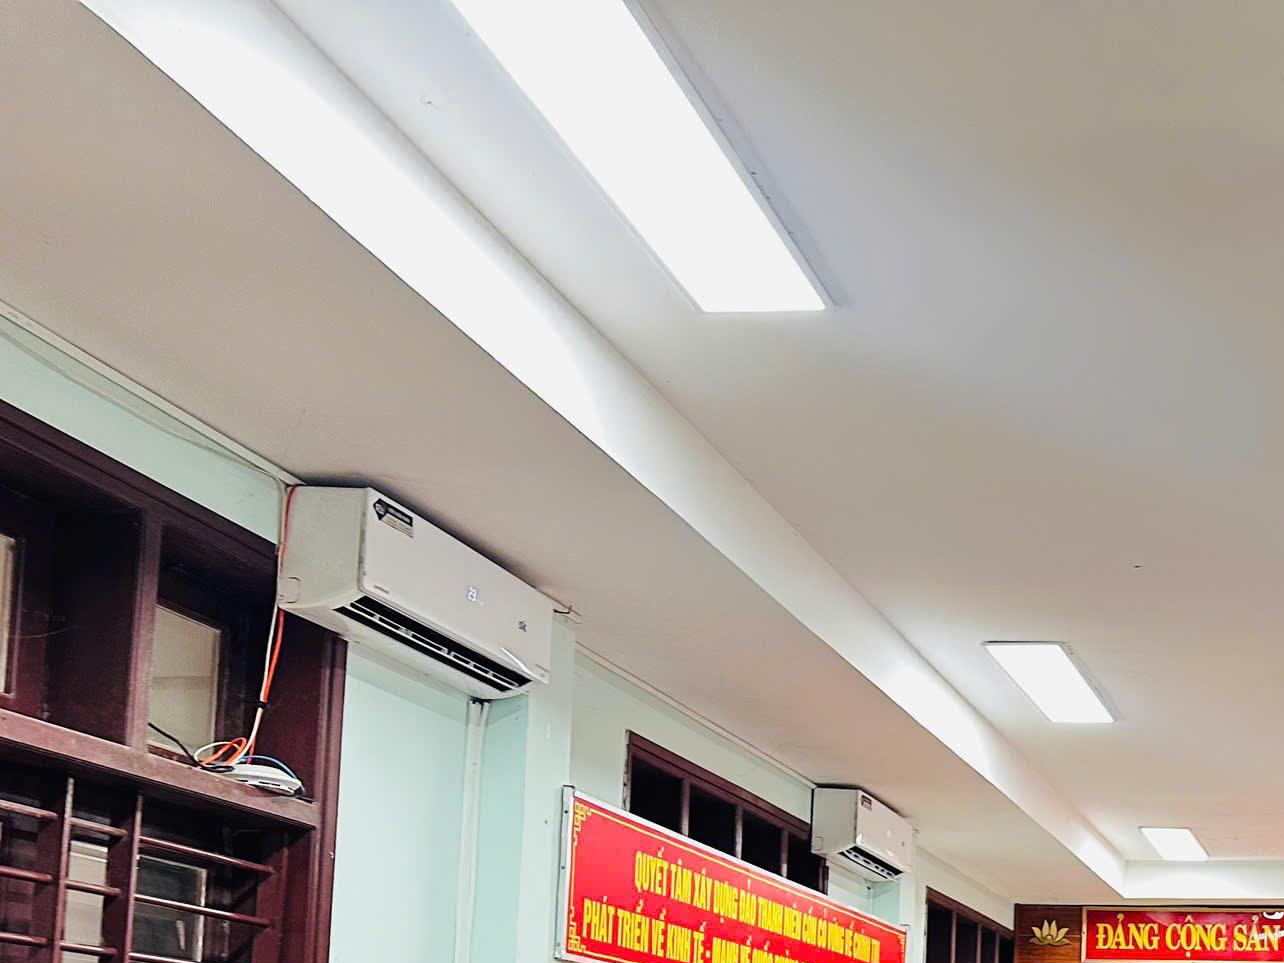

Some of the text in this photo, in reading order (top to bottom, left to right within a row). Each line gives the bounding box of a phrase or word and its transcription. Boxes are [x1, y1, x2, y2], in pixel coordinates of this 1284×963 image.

[635, 846, 668, 896] QUYẾT
[670, 858, 692, 904] TÂM
[693, 867, 713, 911] XÂY
[713, 879, 739, 923] DỰNG
[739, 878, 757, 926] ĐẢO
[582, 896, 615, 944] PHÁT
[617, 900, 650, 952] TRIỂN
[651, 908, 665, 957] VỀ
[666, 923, 692, 963] KINH
[1095, 913, 1160, 950] ĐẢNG
[1165, 915, 1227, 958] CỘNG
[1233, 914, 1279, 951] SẢN
